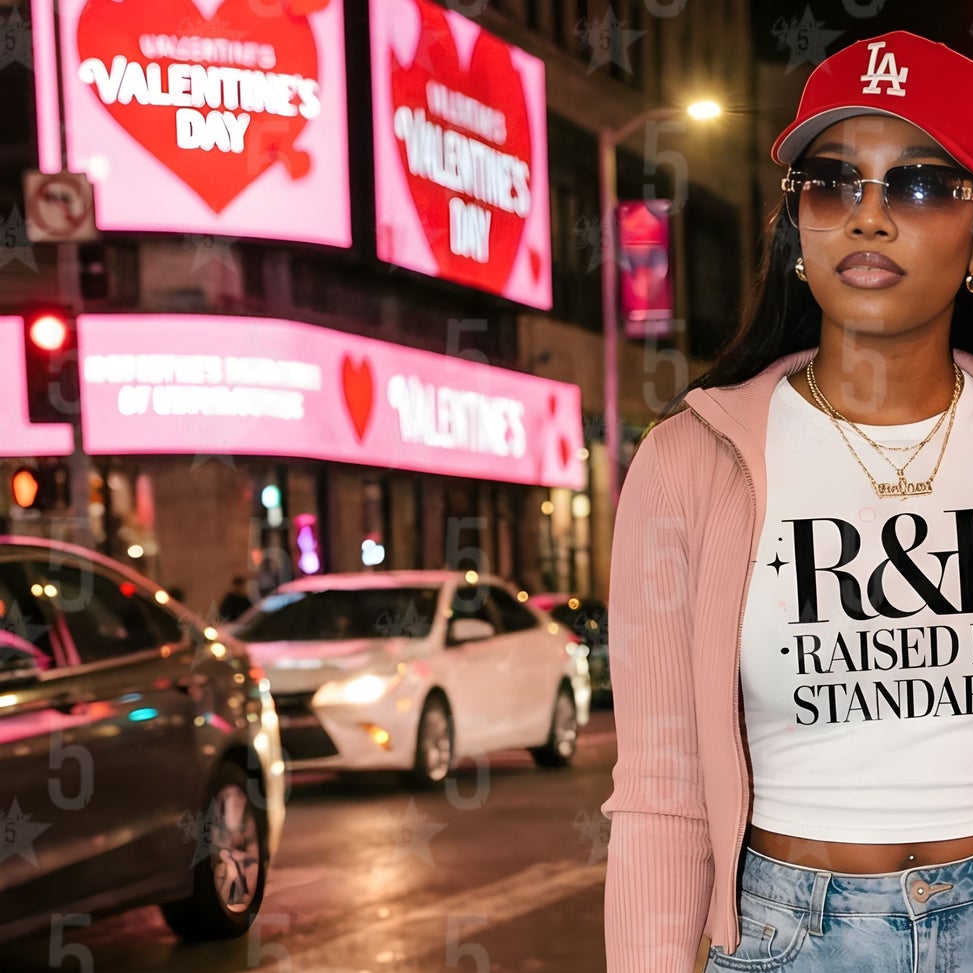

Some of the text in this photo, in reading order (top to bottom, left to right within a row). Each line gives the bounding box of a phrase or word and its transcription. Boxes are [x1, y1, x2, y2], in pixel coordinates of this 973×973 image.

[78, 55, 321, 119] VALENTINE'S
[860, 41, 909, 97] LA
[175, 107, 250, 154] DAY
[792, 625, 959, 675] RAISED
